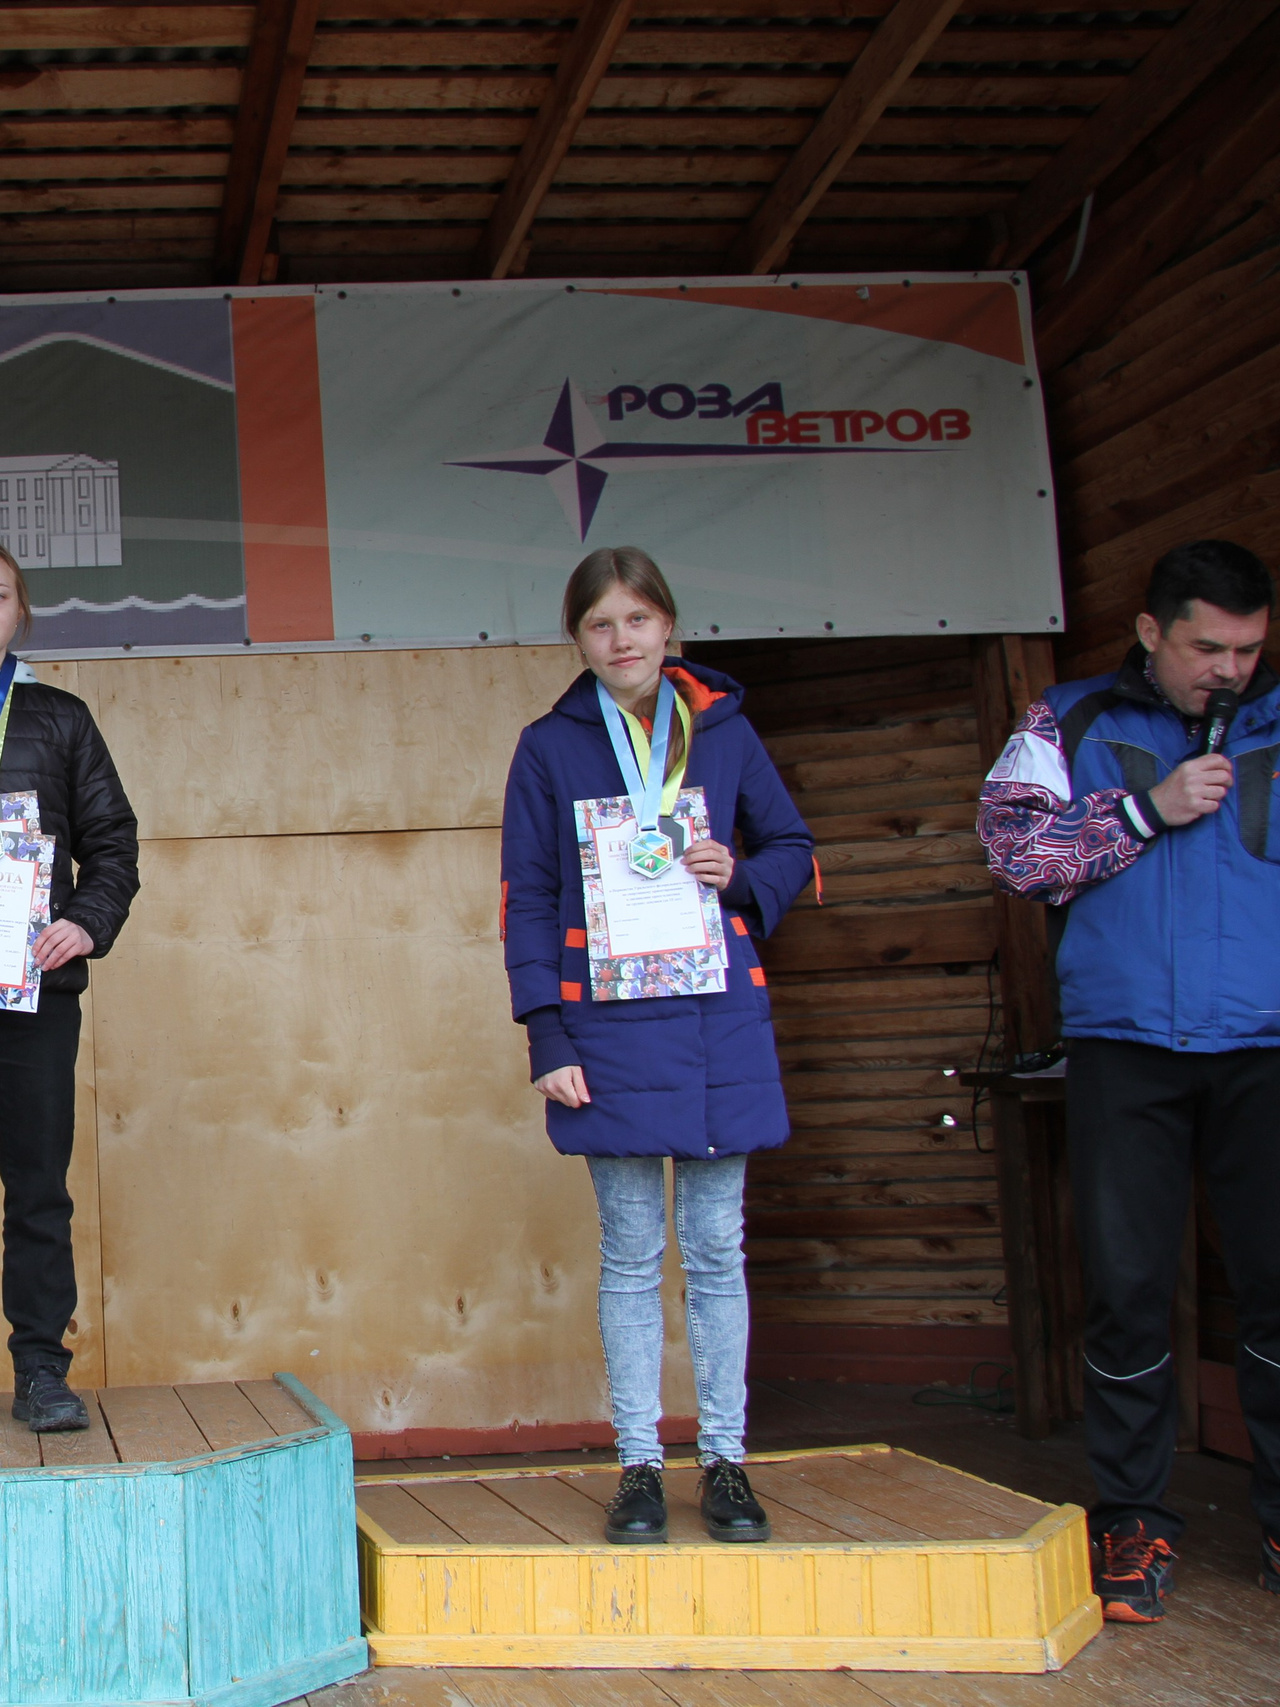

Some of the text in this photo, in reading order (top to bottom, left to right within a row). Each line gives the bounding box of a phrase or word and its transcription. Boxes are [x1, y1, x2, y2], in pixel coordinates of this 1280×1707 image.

[608, 382, 785, 421] РОЗА
[746, 407, 972, 446] ВЕТРОВ
[660, 847, 667, 856] 3
